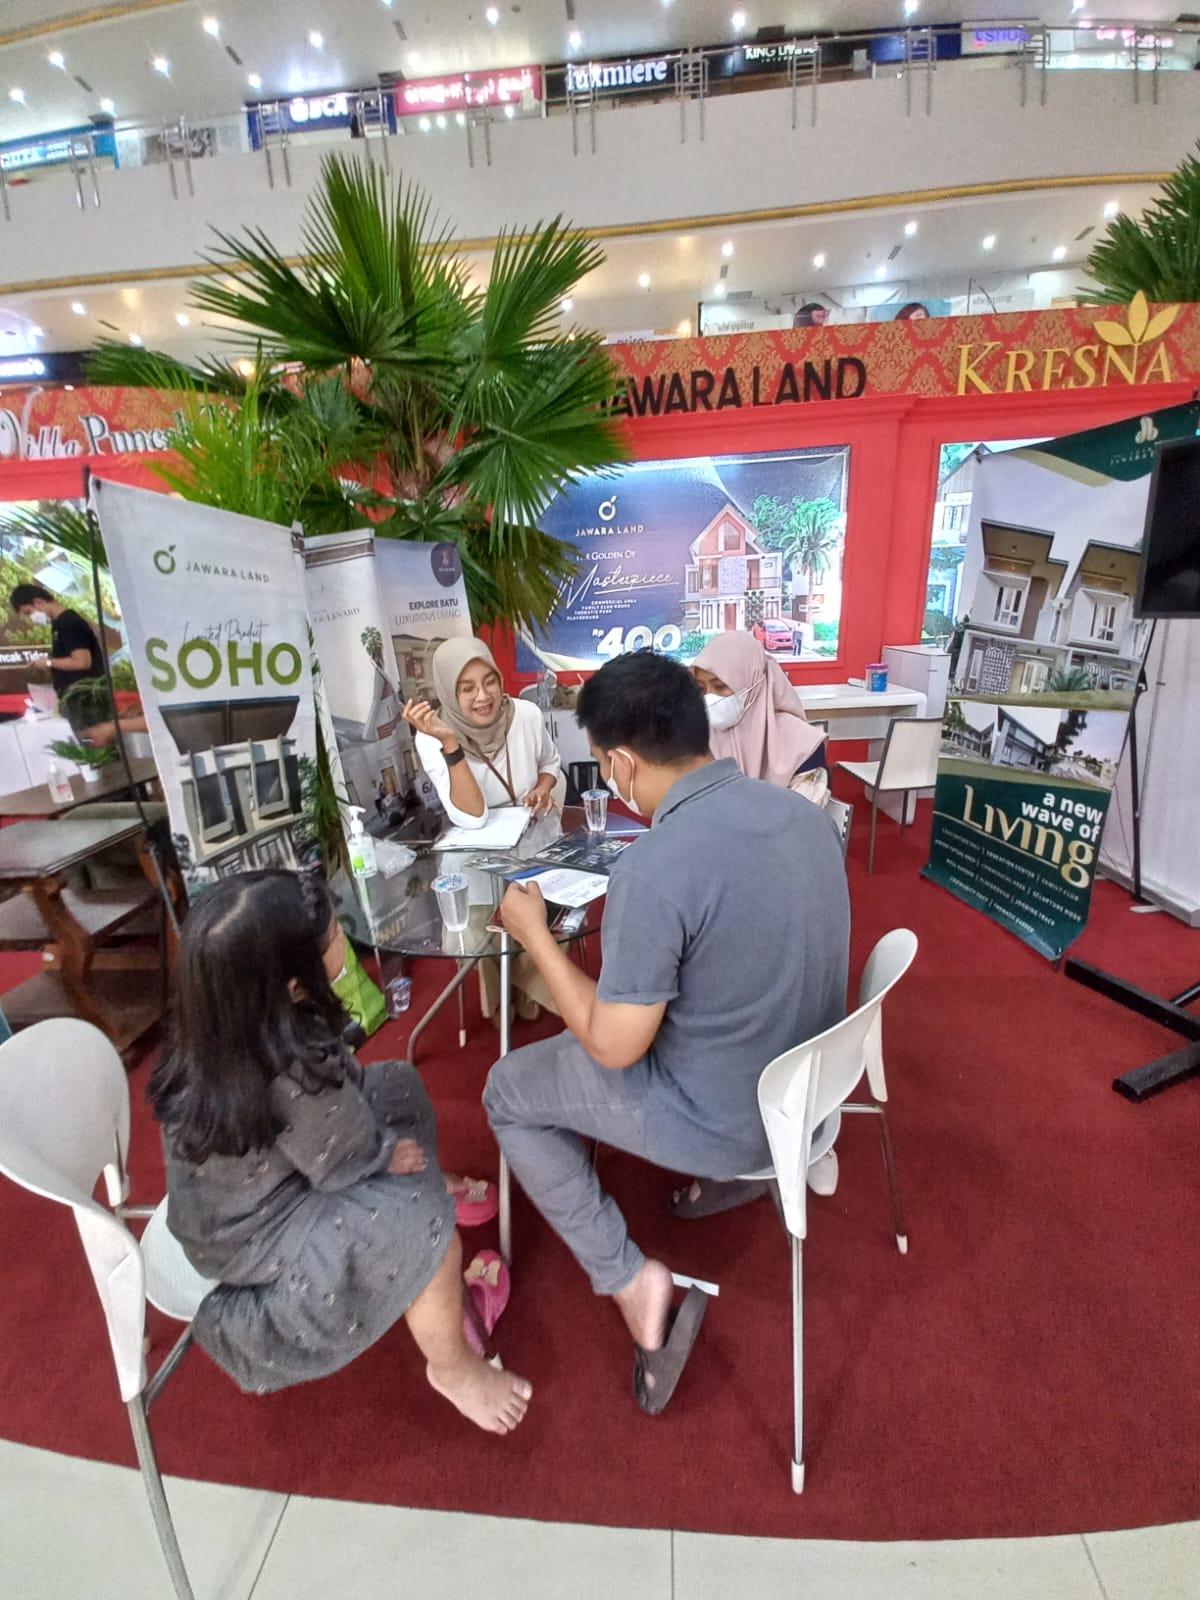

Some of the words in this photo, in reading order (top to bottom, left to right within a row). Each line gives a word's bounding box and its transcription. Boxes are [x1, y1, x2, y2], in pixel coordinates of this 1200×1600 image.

[745, 47, 776, 60] KING
[957, 341, 1172, 396] KRESNA
[601, 367, 742, 417] AWARA
[752, 356, 867, 406] LAND
[575, 527, 614, 537] JAWARA
[617, 525, 644, 535] LAND
[185, 562, 237, 578] JAWARA
[240, 569, 269, 583] LAND
[409, 600, 439, 611] EXPLORE
[440, 598, 459, 608] BATU
[592, 629, 604, 638] Rp
[597, 624, 681, 656] 400
[145, 637, 302, 693] SOHO
[1021, 802, 1074, 832] wave
[1079, 825, 1100, 842] of
[1043, 792, 1053, 807] a
[1060, 797, 1103, 824] new
